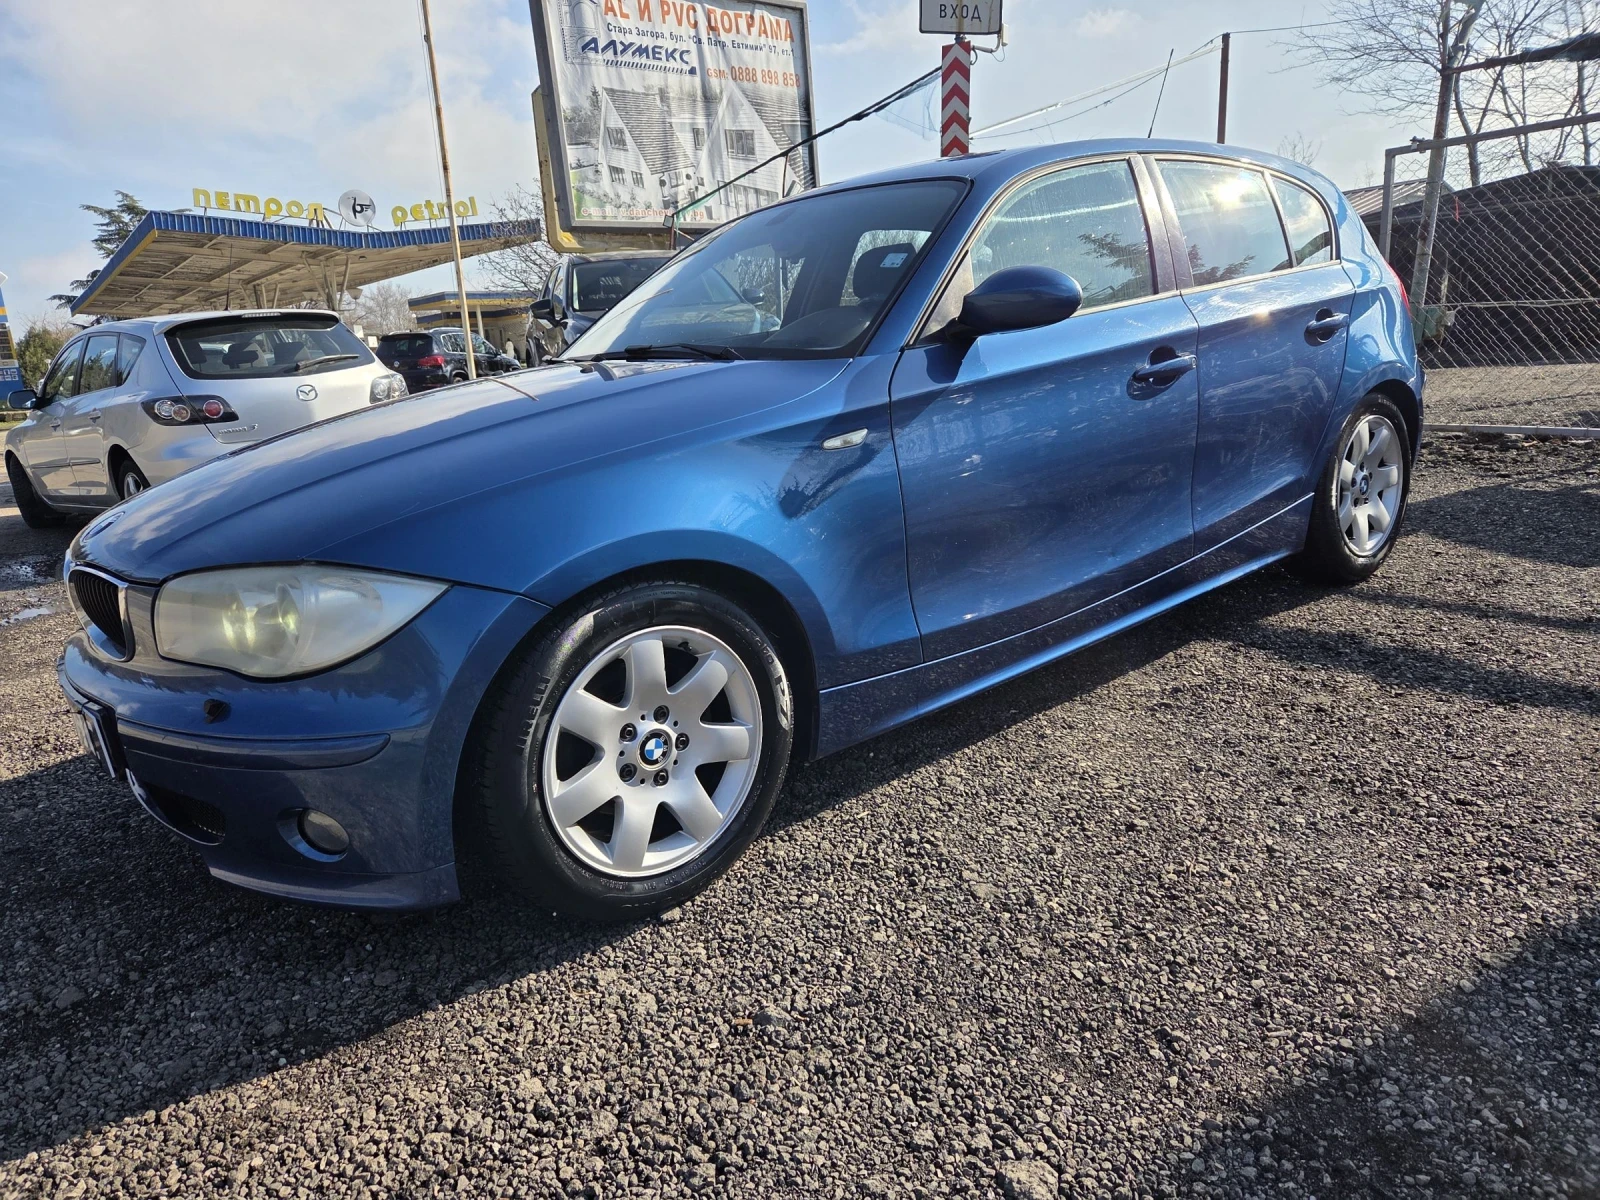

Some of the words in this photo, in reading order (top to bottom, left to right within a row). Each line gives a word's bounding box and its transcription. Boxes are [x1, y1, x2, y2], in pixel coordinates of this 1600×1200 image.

[637, 0, 652, 22] И
[660, 1, 698, 30] PVC
[706, 8, 795, 42] ДОГРАМА
[939, 3, 982, 22] ВХОД
[581, 36, 691, 64] АЛУМЕКС
[607, 22, 633, 36] Стара
[635, 26, 667, 41] Загора,
[669, 31, 686, 44] бул.
[707, 37, 729, 50] Патр.
[706, 67, 729, 79] GSM:
[730, 65, 758, 83] 0888
[761, 69, 779, 86] 898
[782, 71, 800, 88] 858
[391, 196, 478, 226] petrol
[657, 734, 669, 763] BMW
